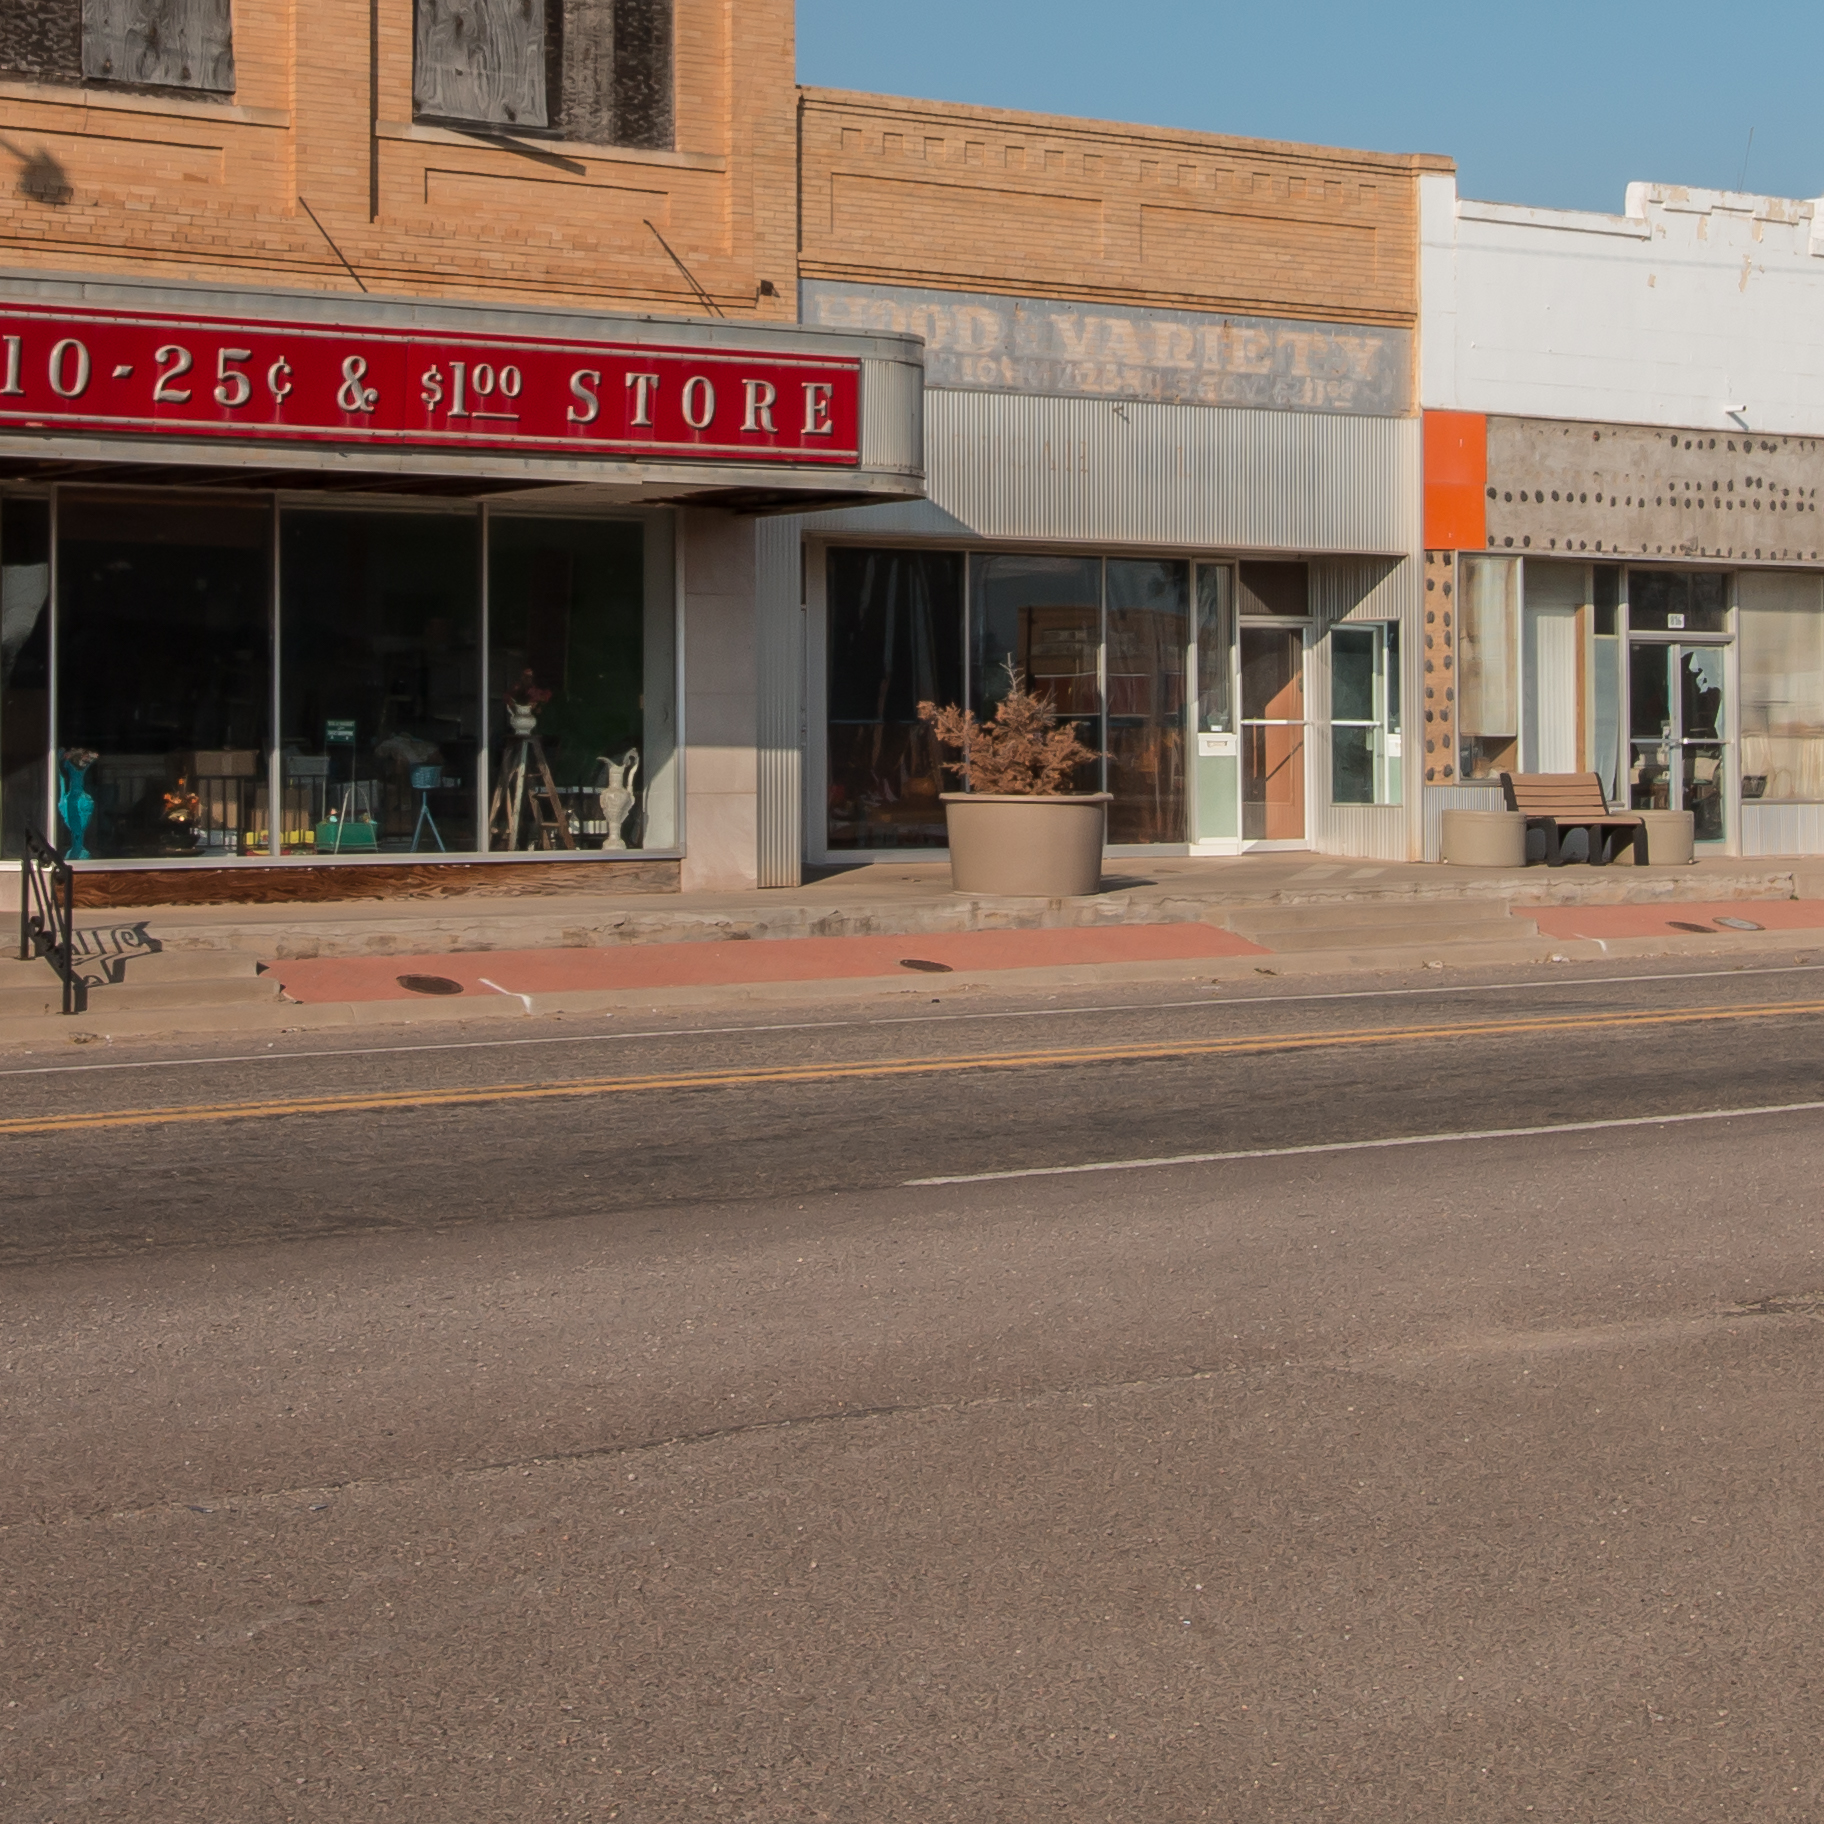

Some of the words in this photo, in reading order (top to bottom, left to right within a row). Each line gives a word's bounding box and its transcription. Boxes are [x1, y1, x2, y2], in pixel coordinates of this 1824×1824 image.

[1049, 312, 1384, 381] VARIETY
[336, 354, 379, 413] &
[567, 368, 834, 436] STORE
